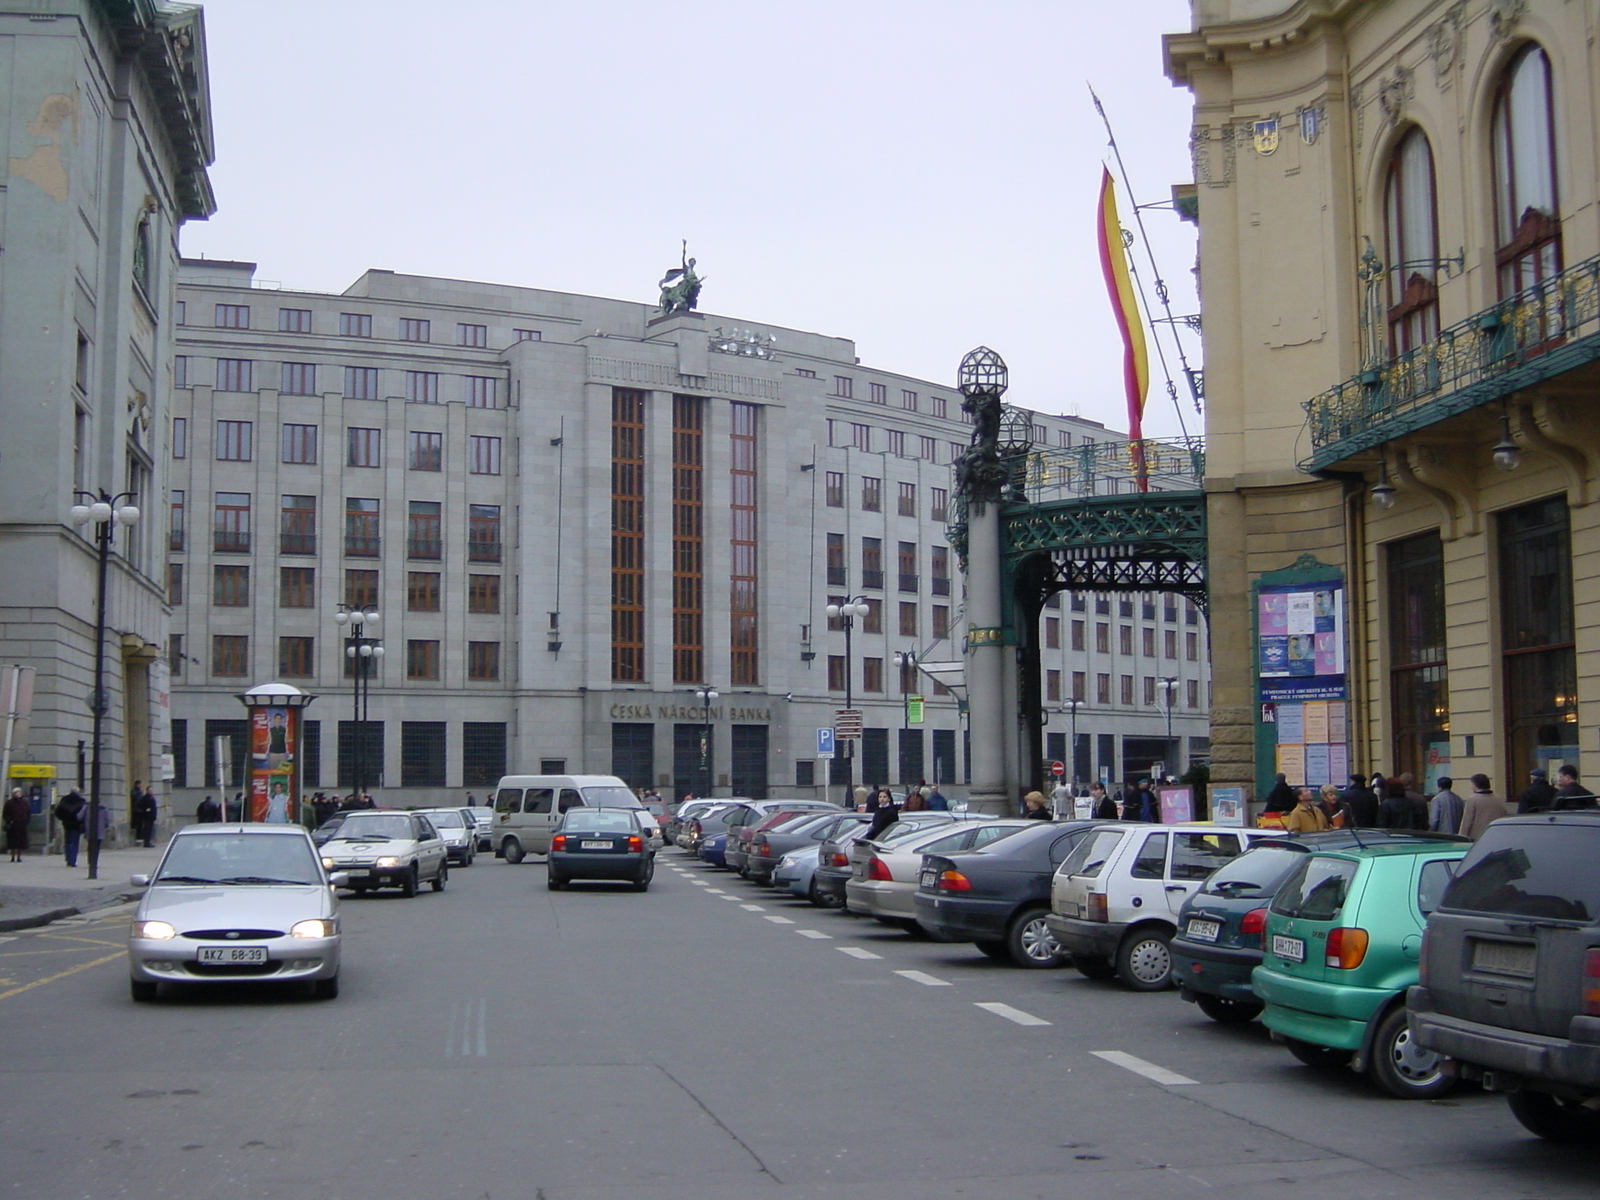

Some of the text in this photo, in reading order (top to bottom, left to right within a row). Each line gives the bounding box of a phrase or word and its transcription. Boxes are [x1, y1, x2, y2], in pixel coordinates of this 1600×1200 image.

[609, 703, 772, 721] ČESKÁ NÁRODNÍ BANKA
[1262, 703, 1275, 723] fok
[820, 730, 830, 744] P
[203, 949, 262, 961] AKZ 68-39
